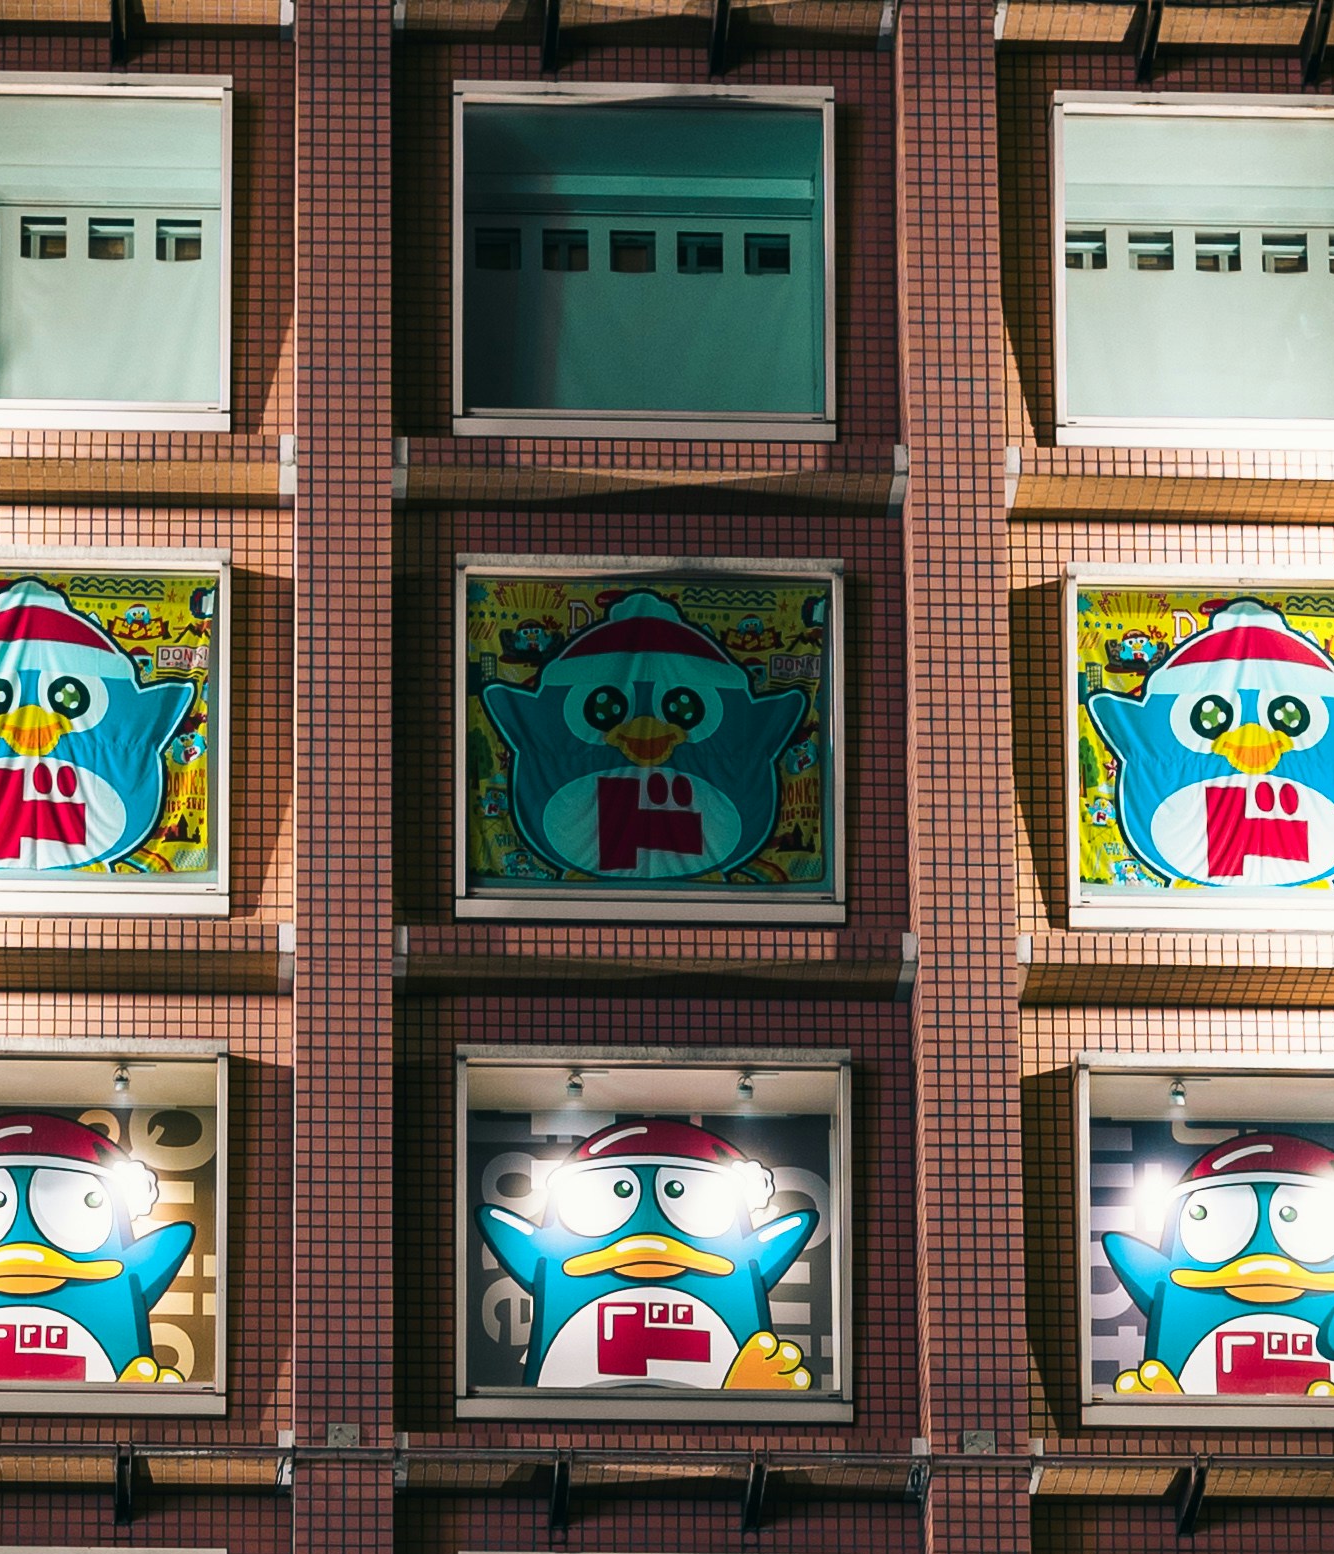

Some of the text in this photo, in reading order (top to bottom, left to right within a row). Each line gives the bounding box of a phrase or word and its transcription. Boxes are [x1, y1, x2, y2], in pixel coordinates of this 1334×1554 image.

[160, 647, 208, 663] DONKI
[597, 774, 703, 870] ド
[1206, 780, 1309, 878] ド
